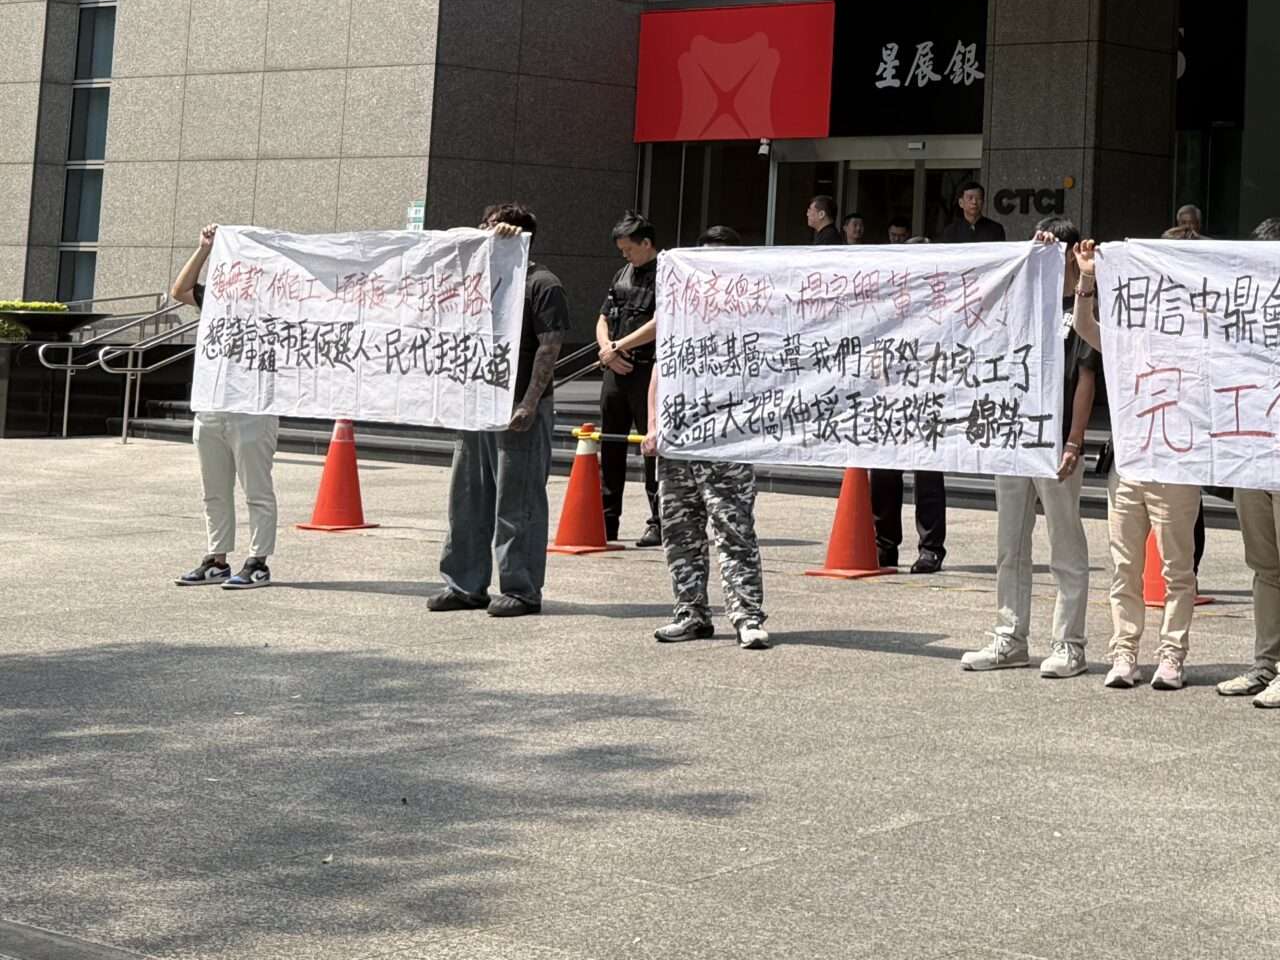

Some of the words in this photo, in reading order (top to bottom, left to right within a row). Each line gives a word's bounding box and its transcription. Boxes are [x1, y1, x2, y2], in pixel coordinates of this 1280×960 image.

[874, 39, 985, 89] 星展銀
[993, 188, 1065, 216] CTCI
